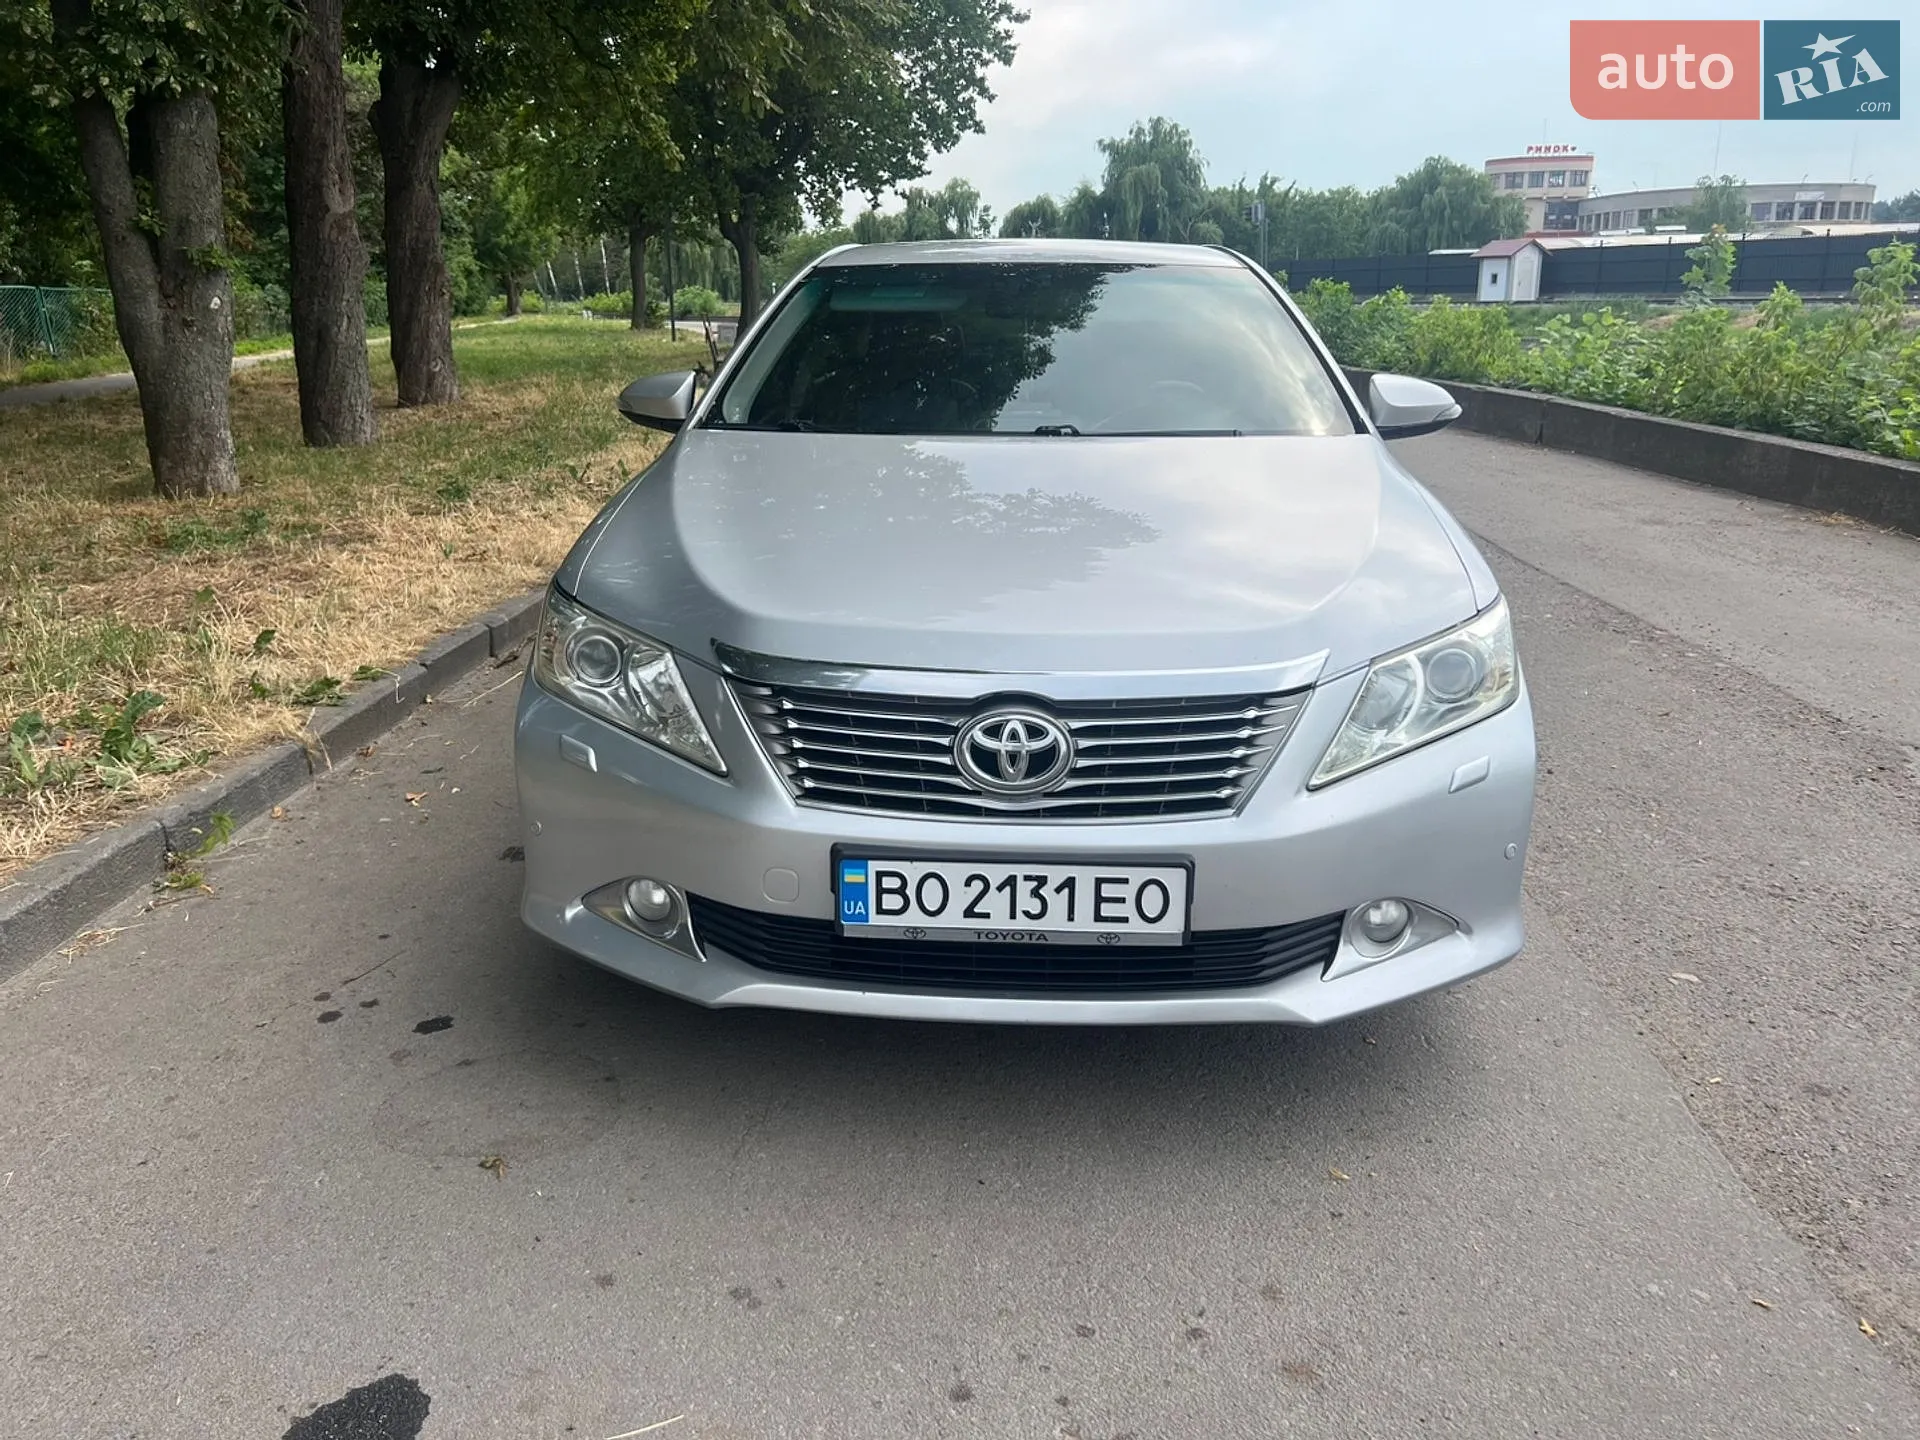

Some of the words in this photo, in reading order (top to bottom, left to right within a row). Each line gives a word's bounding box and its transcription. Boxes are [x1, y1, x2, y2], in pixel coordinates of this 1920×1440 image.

[875, 869, 950, 918] BO
[962, 873, 1076, 923] 2131
[1093, 876, 1170, 924] EO
[844, 900, 866, 915] UA
[973, 931, 1049, 942] TOYOTA
